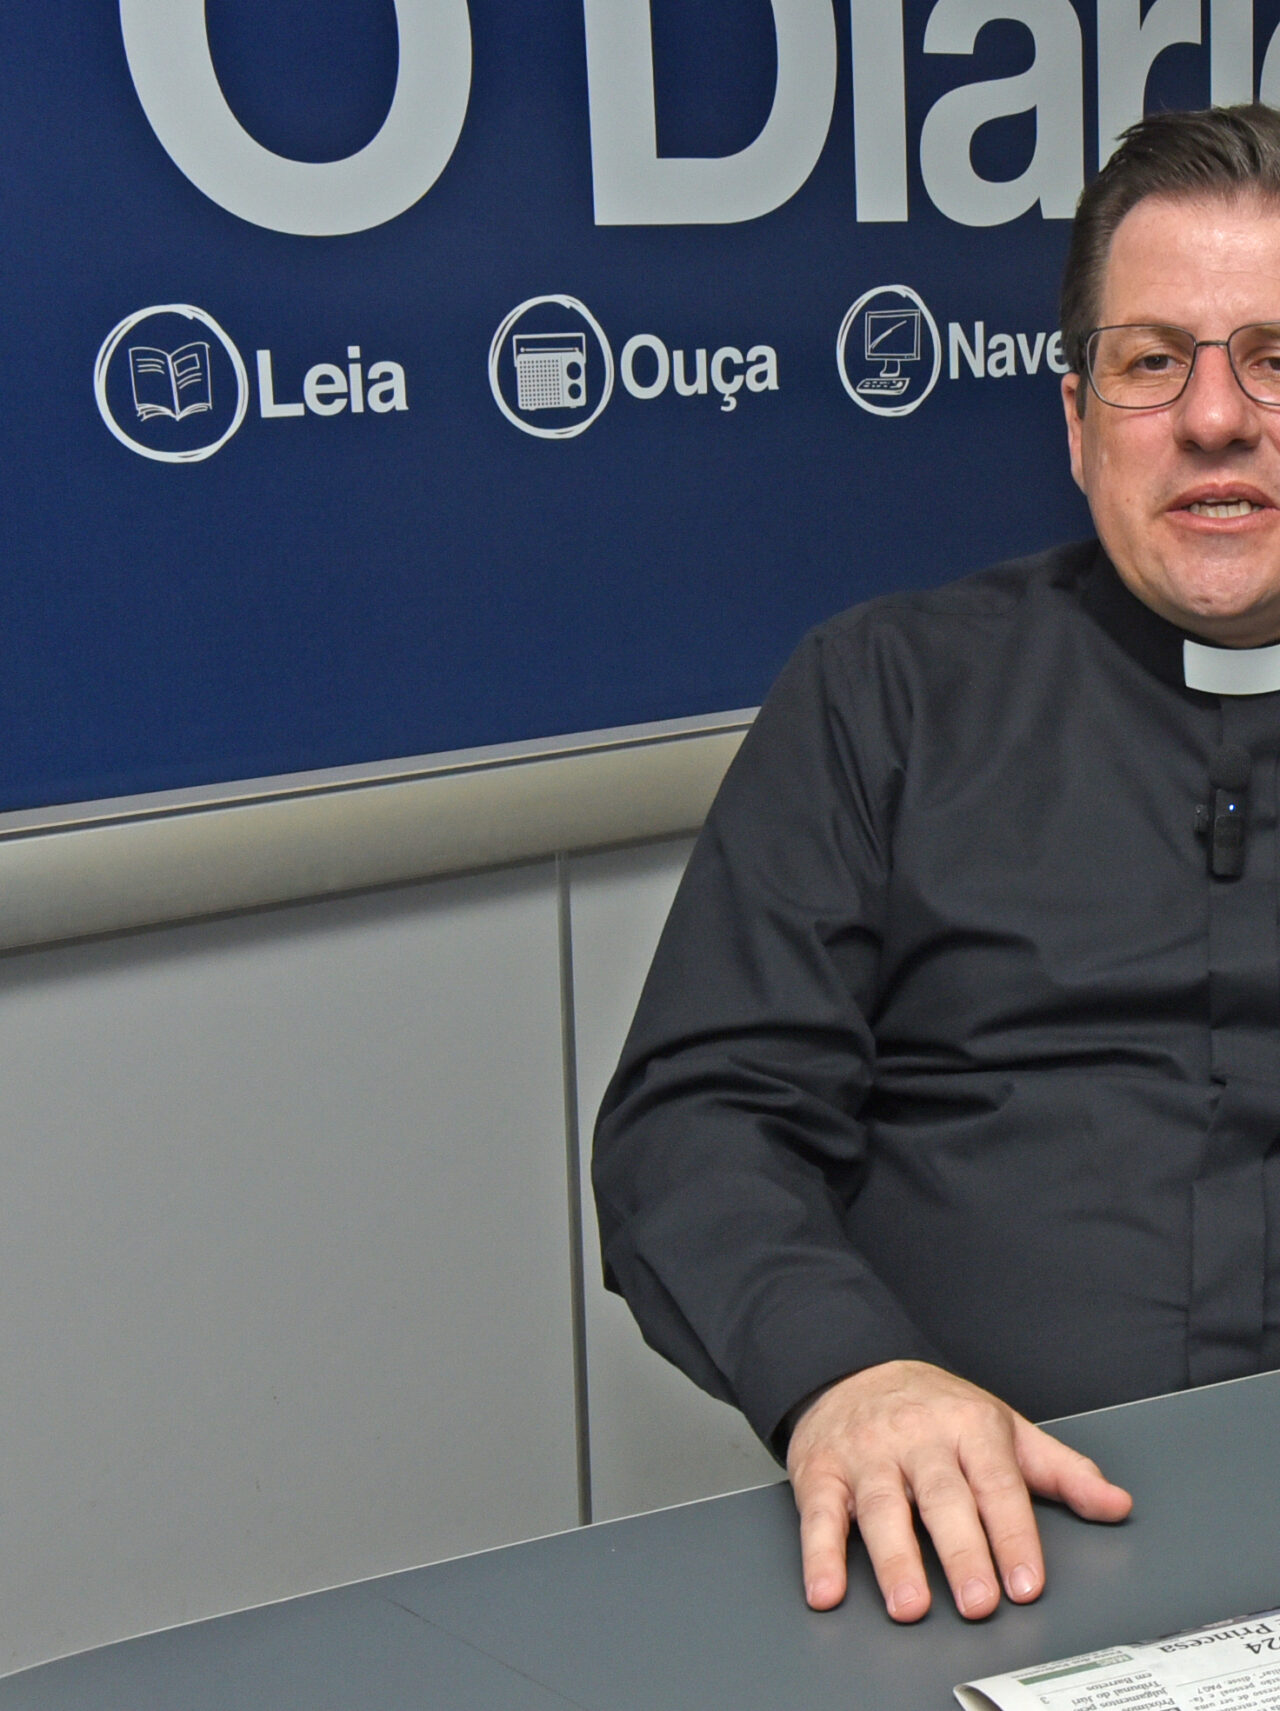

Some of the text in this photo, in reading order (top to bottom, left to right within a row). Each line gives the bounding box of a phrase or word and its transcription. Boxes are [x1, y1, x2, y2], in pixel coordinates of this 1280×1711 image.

[118, 0, 472, 236] O
[256, 345, 409, 418] Leia
[620, 333, 779, 411] Ouça
[1158, 1623, 1274, 1653] Princesa
[1039, 1672, 1152, 1704] em Barretos 3
[1071, 1695, 1093, 1706] Júri
[1099, 1686, 1168, 1708] julgamentos
[1112, 1680, 1161, 1696] Tribunal
